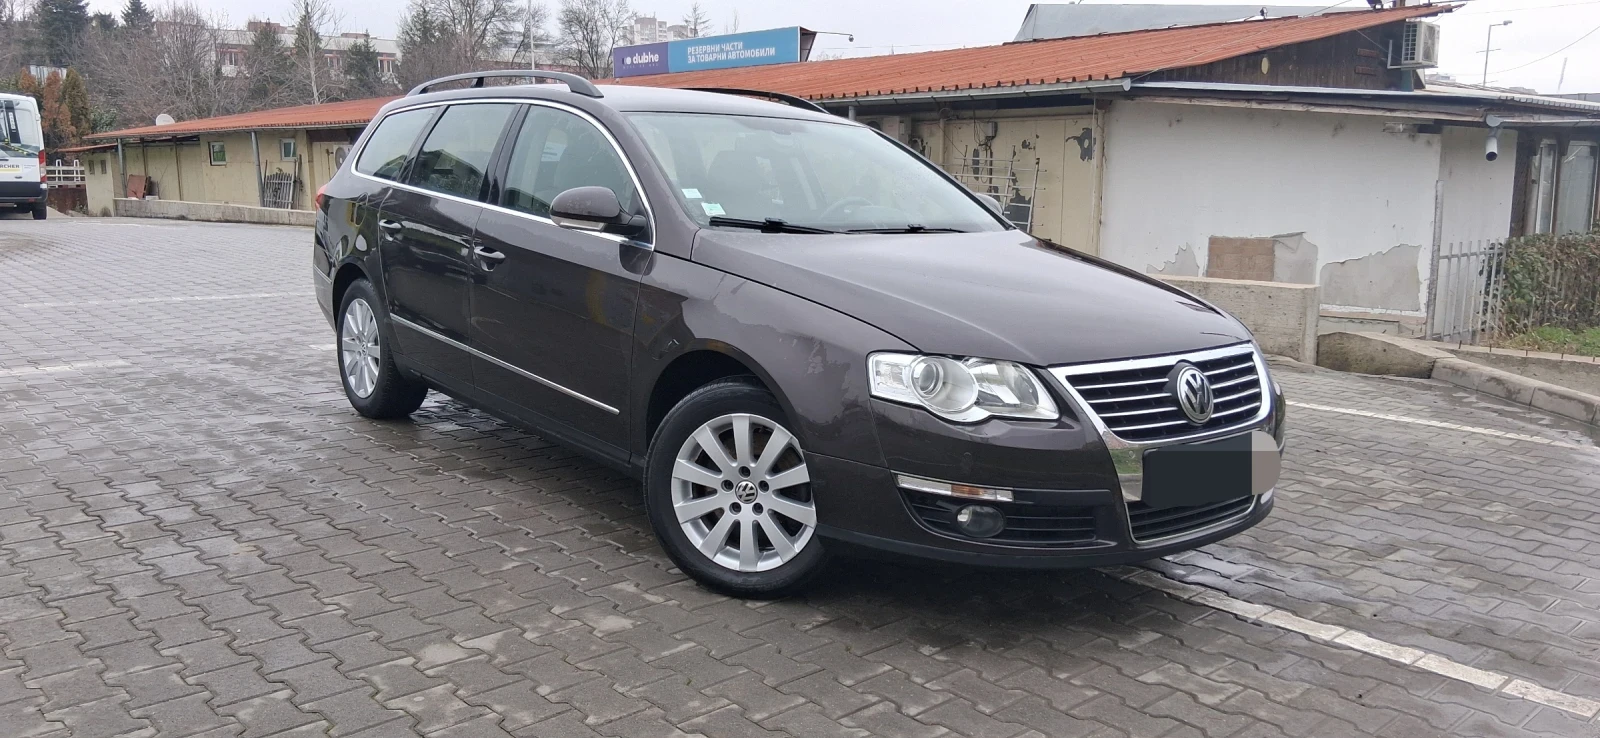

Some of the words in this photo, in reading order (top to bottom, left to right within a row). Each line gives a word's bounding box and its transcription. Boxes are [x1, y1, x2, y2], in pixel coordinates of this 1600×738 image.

[687, 43, 720, 55] РЕЗЕРВНИ
[721, 41, 743, 52] ЧАСТИ
[632, 51, 659, 64] dubhe
[687, 55, 696, 64] ЗА
[696, 52, 727, 63] ТОВАРНИ
[727, 47, 776, 61] АВТОМОБИЛИ
